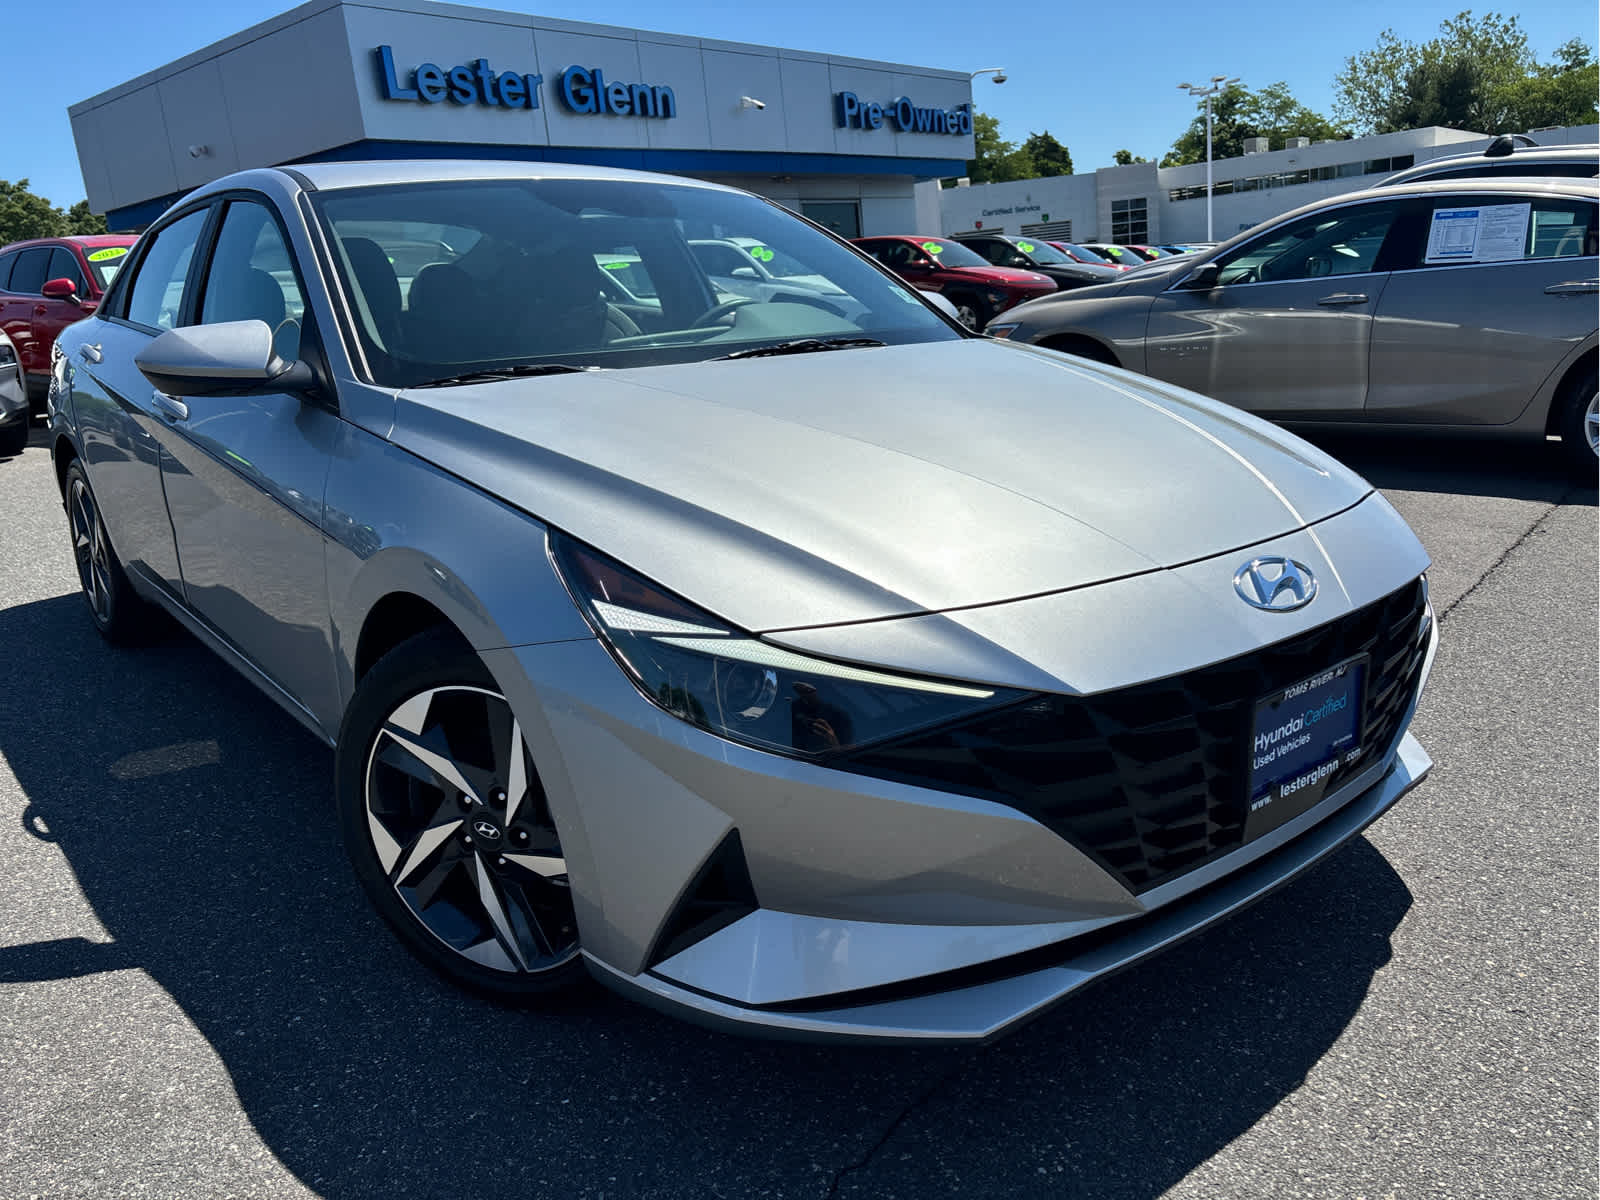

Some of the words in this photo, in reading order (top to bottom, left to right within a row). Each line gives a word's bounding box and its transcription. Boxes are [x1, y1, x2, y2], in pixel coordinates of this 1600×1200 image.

[376, 45, 543, 109] Lester
[558, 65, 677, 119] Glenn
[835, 91, 972, 135] Pre-Owned
[1253, 713, 1304, 753] Hyundai
[1304, 693, 1347, 726] Certified
[1253, 751, 1276, 770] Used
[1276, 732, 1311, 758] Vehicles
[1280, 759, 1340, 798] lesterglenn
